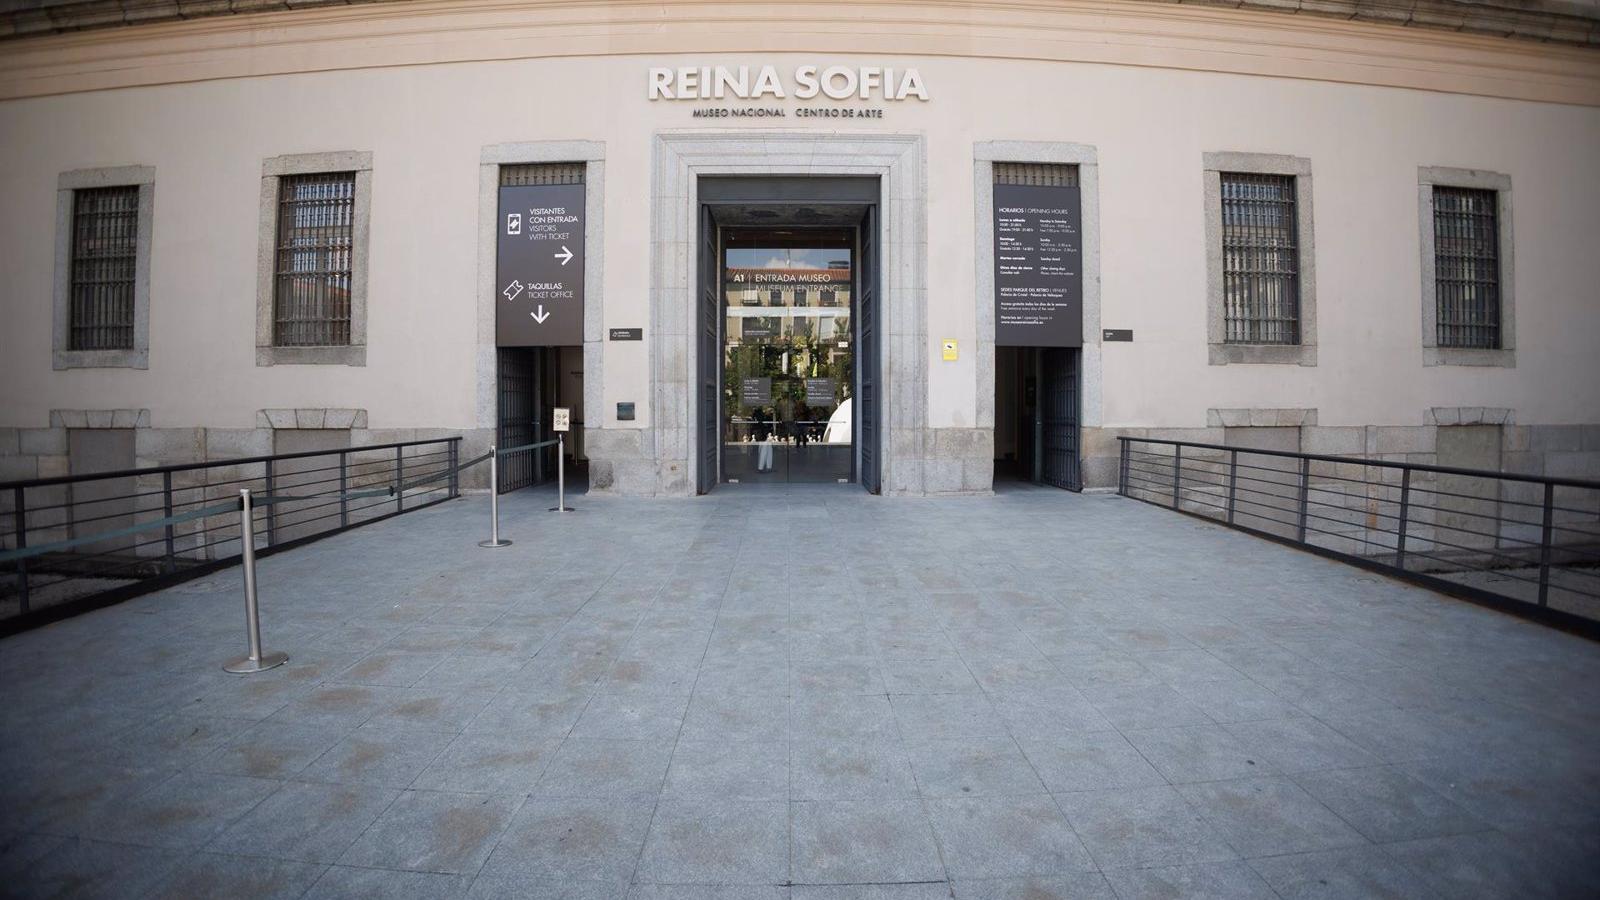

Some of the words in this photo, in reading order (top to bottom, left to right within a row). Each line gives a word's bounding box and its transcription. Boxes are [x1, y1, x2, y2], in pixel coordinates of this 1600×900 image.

[648, 65, 785, 100] REINA
[793, 65, 930, 101] SOFIA
[692, 108, 728, 118] MUSEO
[730, 108, 786, 118] NACIONAL
[796, 108, 839, 118] CENTRO
[842, 108, 854, 118] DE
[857, 109, 883, 119] ARTE
[529, 207, 565, 215] VISITANTES
[529, 216, 546, 224] CON
[547, 215, 578, 223] ENTRADA
[529, 233, 547, 241] WITH
[548, 232, 570, 240] TICKET
[733, 274, 745, 282] A1
[755, 274, 797, 282] ENTRADA
[798, 274, 831, 282] MUSEO
[527, 282, 563, 290] TAQUILLAS
[755, 284, 794, 293] MUSEUM
[528, 291, 549, 299] TICKET
[550, 290, 573, 298] OFFICE
